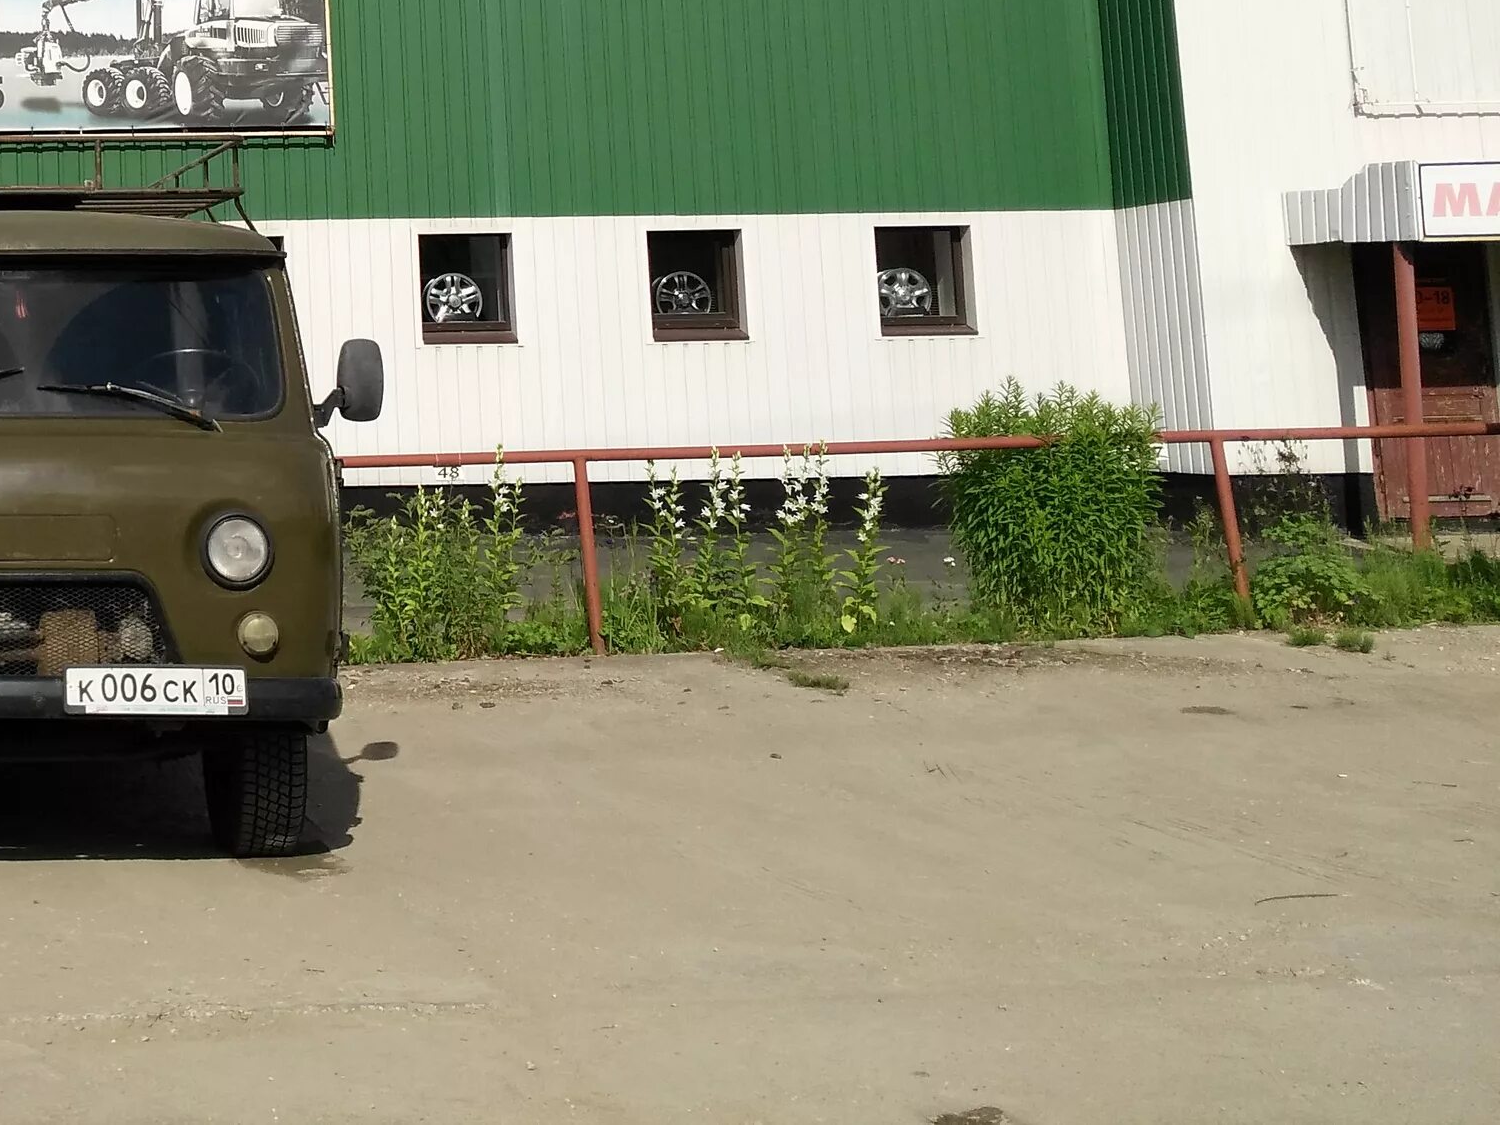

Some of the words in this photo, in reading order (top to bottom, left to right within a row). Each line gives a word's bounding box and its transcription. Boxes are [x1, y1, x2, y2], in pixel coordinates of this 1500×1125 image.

[437, 466, 460, 479] 48
[208, 673, 236, 696] 10
[205, 696, 227, 705] RUS
